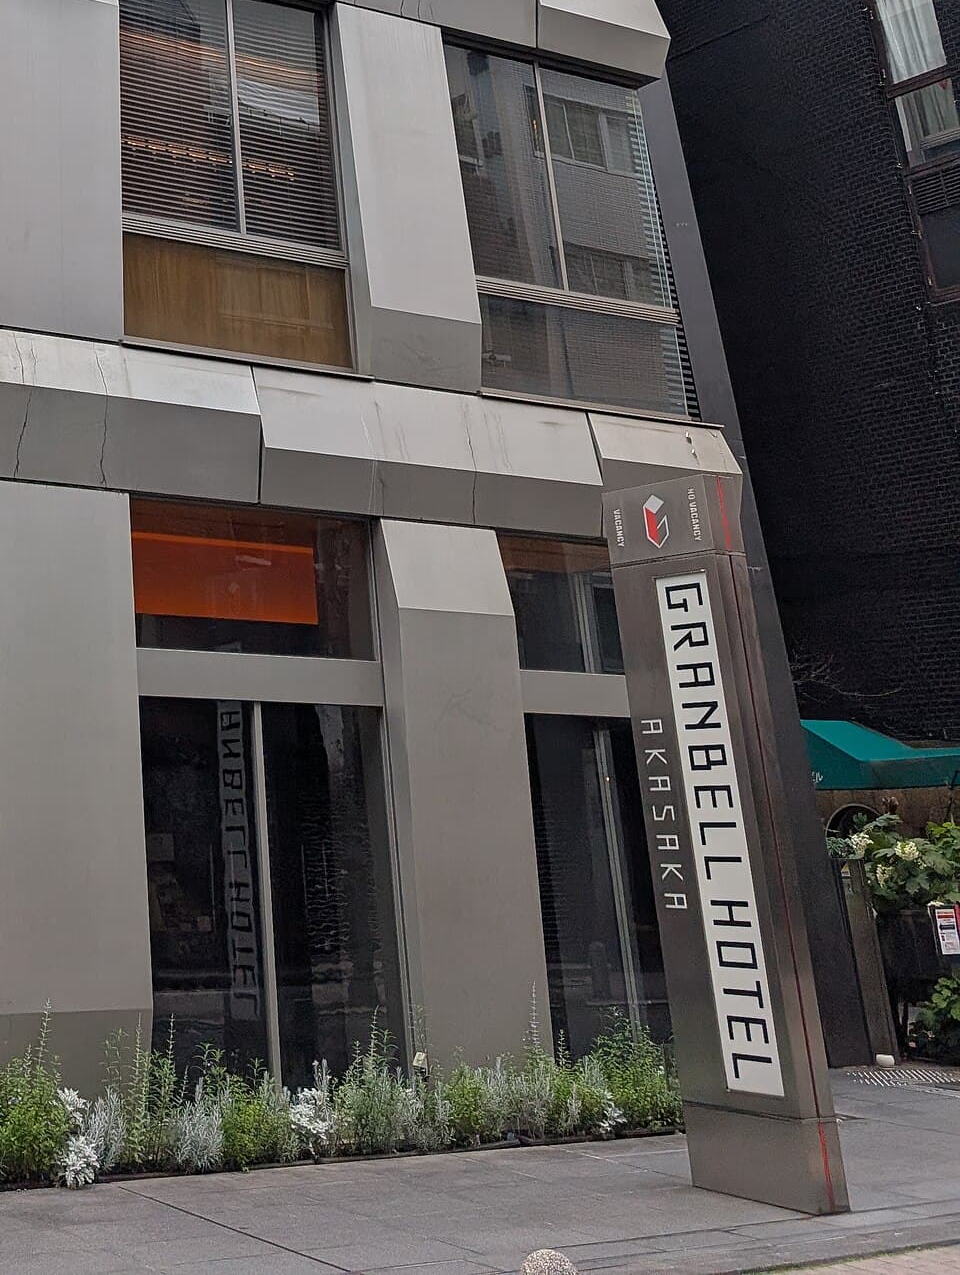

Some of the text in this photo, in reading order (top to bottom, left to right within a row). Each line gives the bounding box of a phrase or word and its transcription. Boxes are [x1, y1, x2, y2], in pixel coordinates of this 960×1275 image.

[613, 508, 625, 548] VACANCY
[687, 488, 702, 542] NO VACANCY
[641, 718, 688, 910] AKASAKA
[665, 582, 773, 1079] GRANBELL HOTEL
